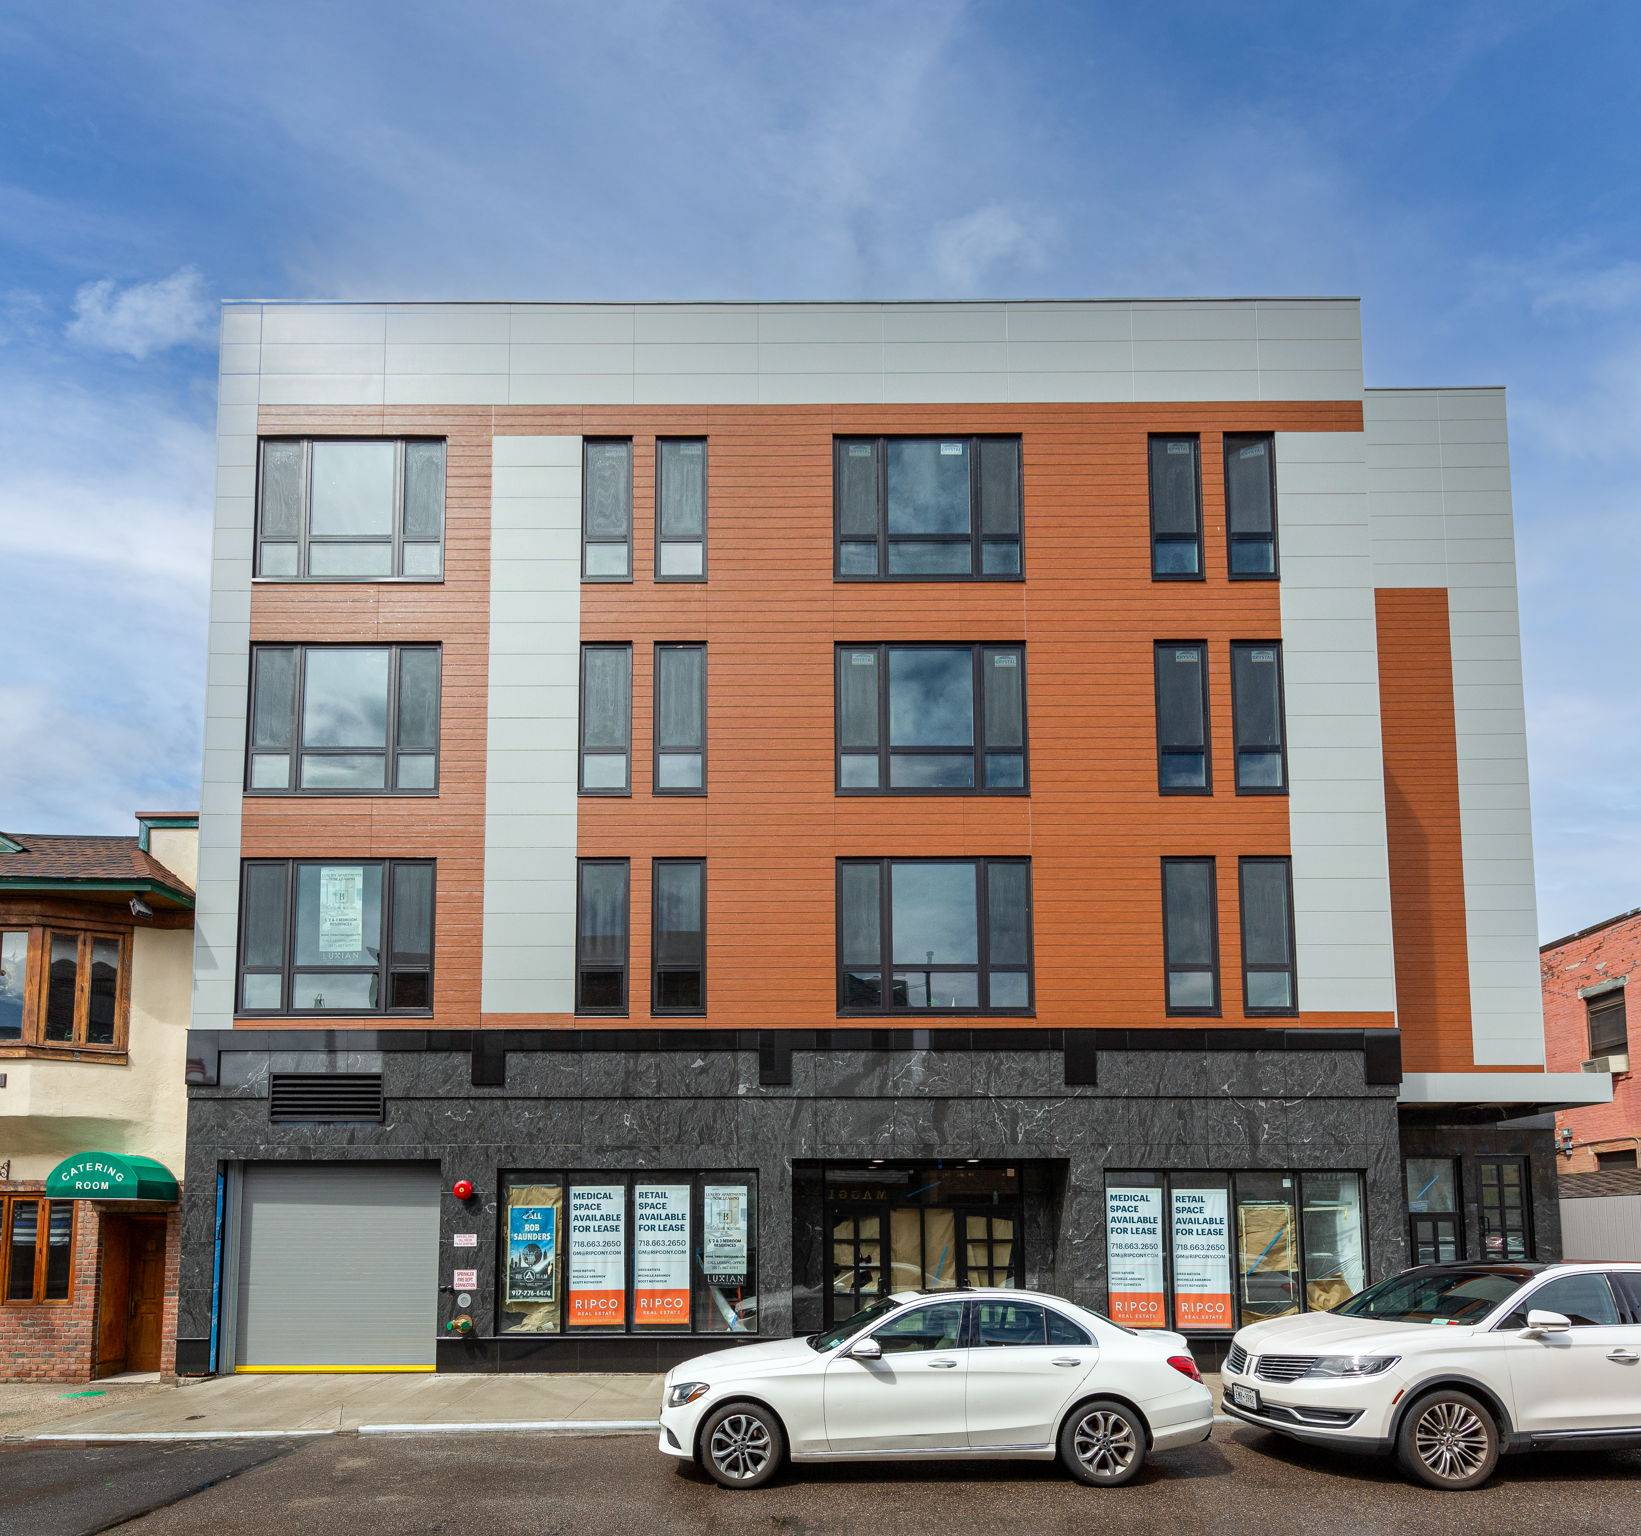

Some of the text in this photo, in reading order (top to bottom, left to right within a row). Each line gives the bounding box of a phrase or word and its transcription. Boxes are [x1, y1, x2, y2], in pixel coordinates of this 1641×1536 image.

[322, 952, 361, 960] LUXIAN
[62, 1162, 124, 1182] CATERING
[576, 1299, 618, 1309] RIPCO
[641, 1298, 683, 1308] RIPCO
[1116, 1302, 1158, 1311] RIPCO
[1181, 1303, 1224, 1312] RIPCO
